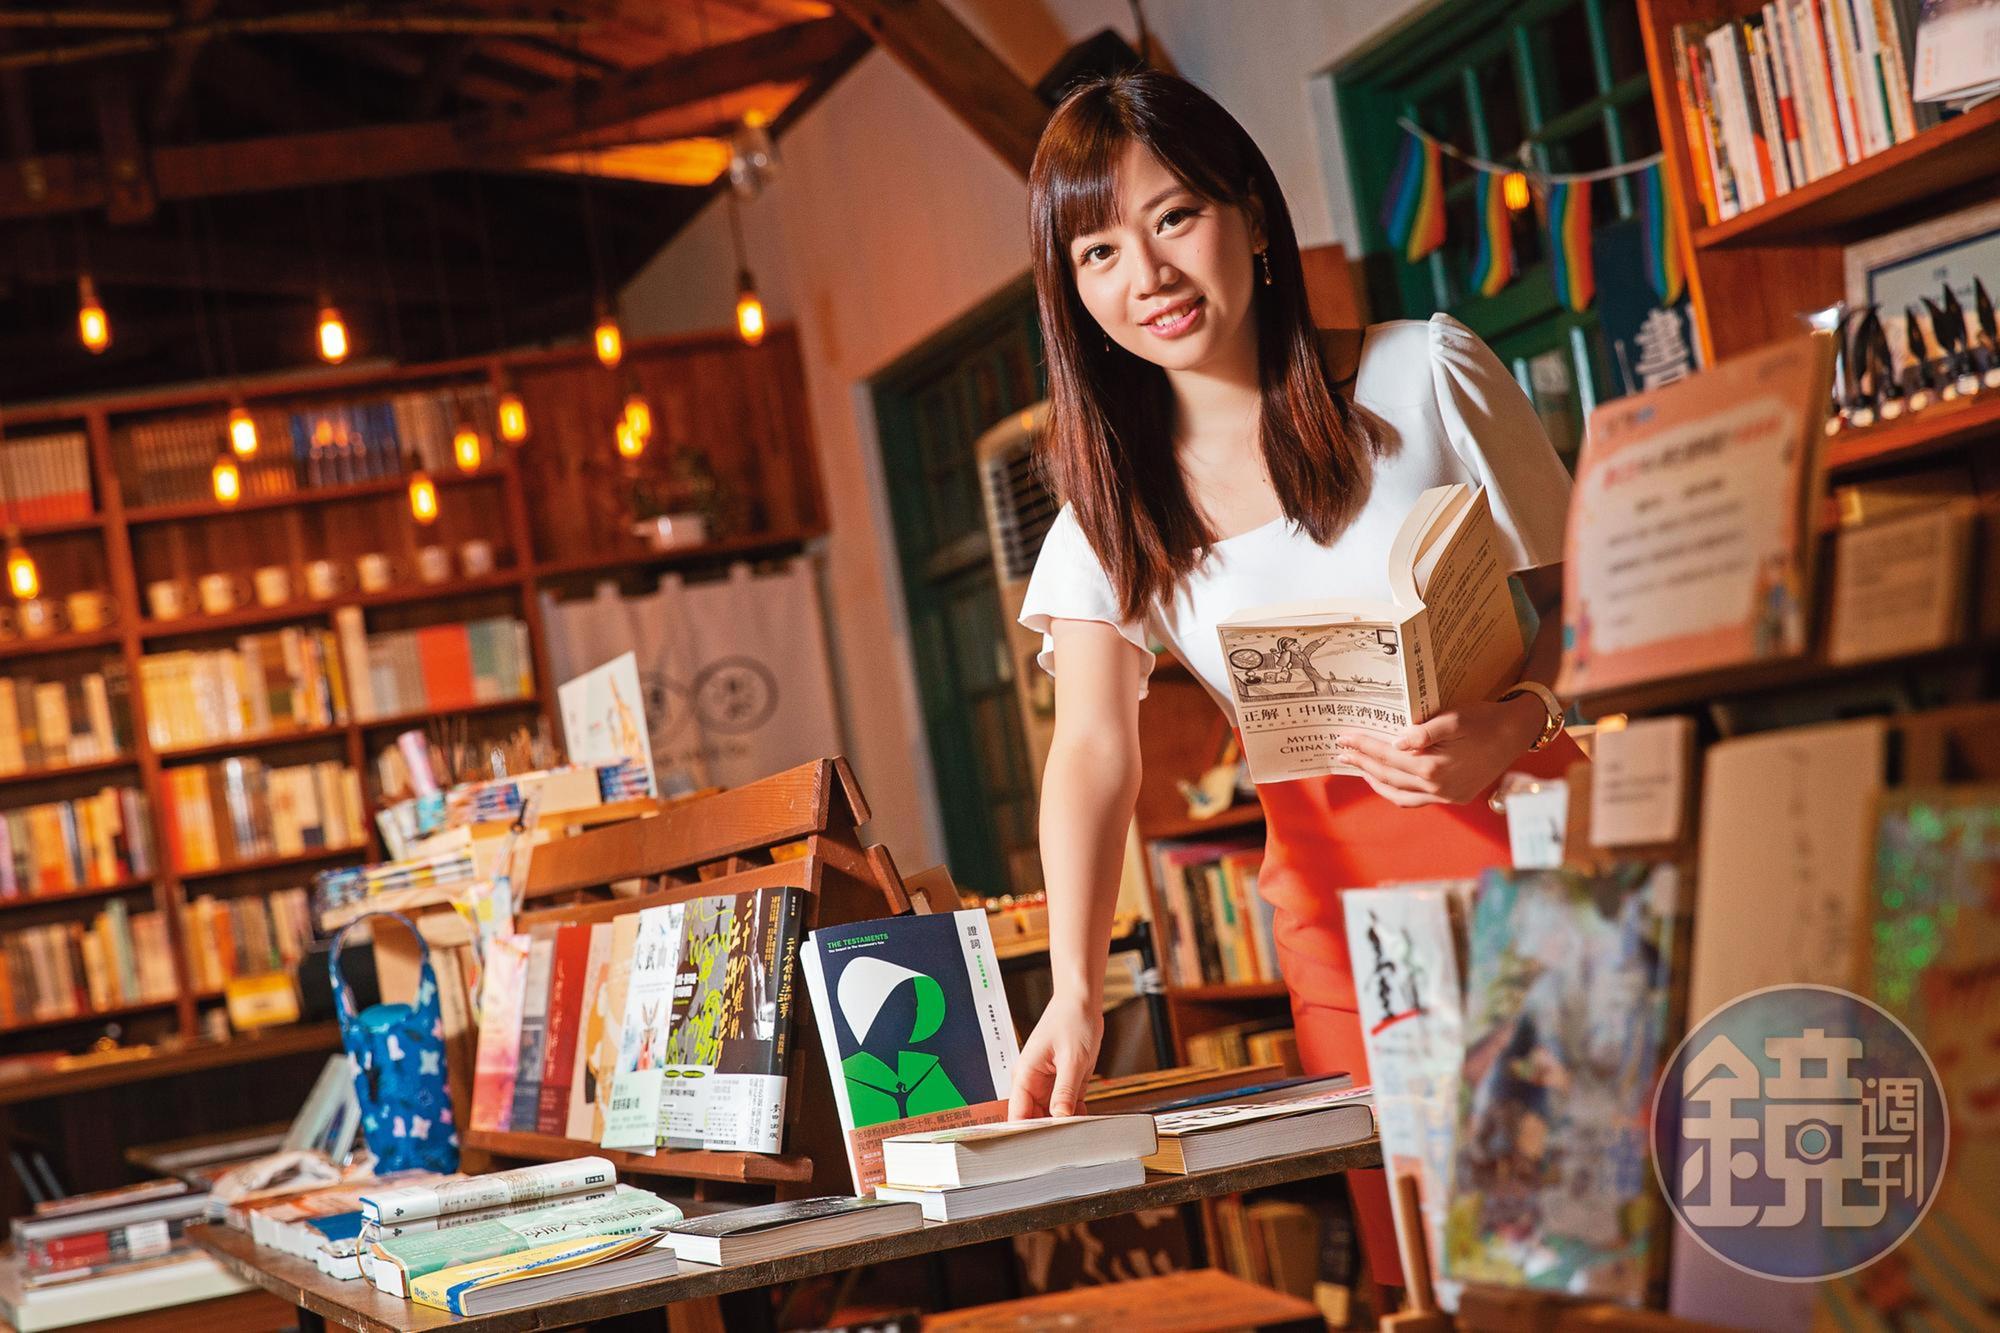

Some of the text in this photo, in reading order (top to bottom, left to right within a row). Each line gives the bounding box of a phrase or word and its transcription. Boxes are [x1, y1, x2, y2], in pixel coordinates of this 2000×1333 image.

[1244, 704, 1407, 726] 正解！中國經濟數據
[1287, 733, 1341, 744] MYTH-B
[827, 933, 888, 949] THE TESTAMENTS
[967, 926, 981, 949] 證詞
